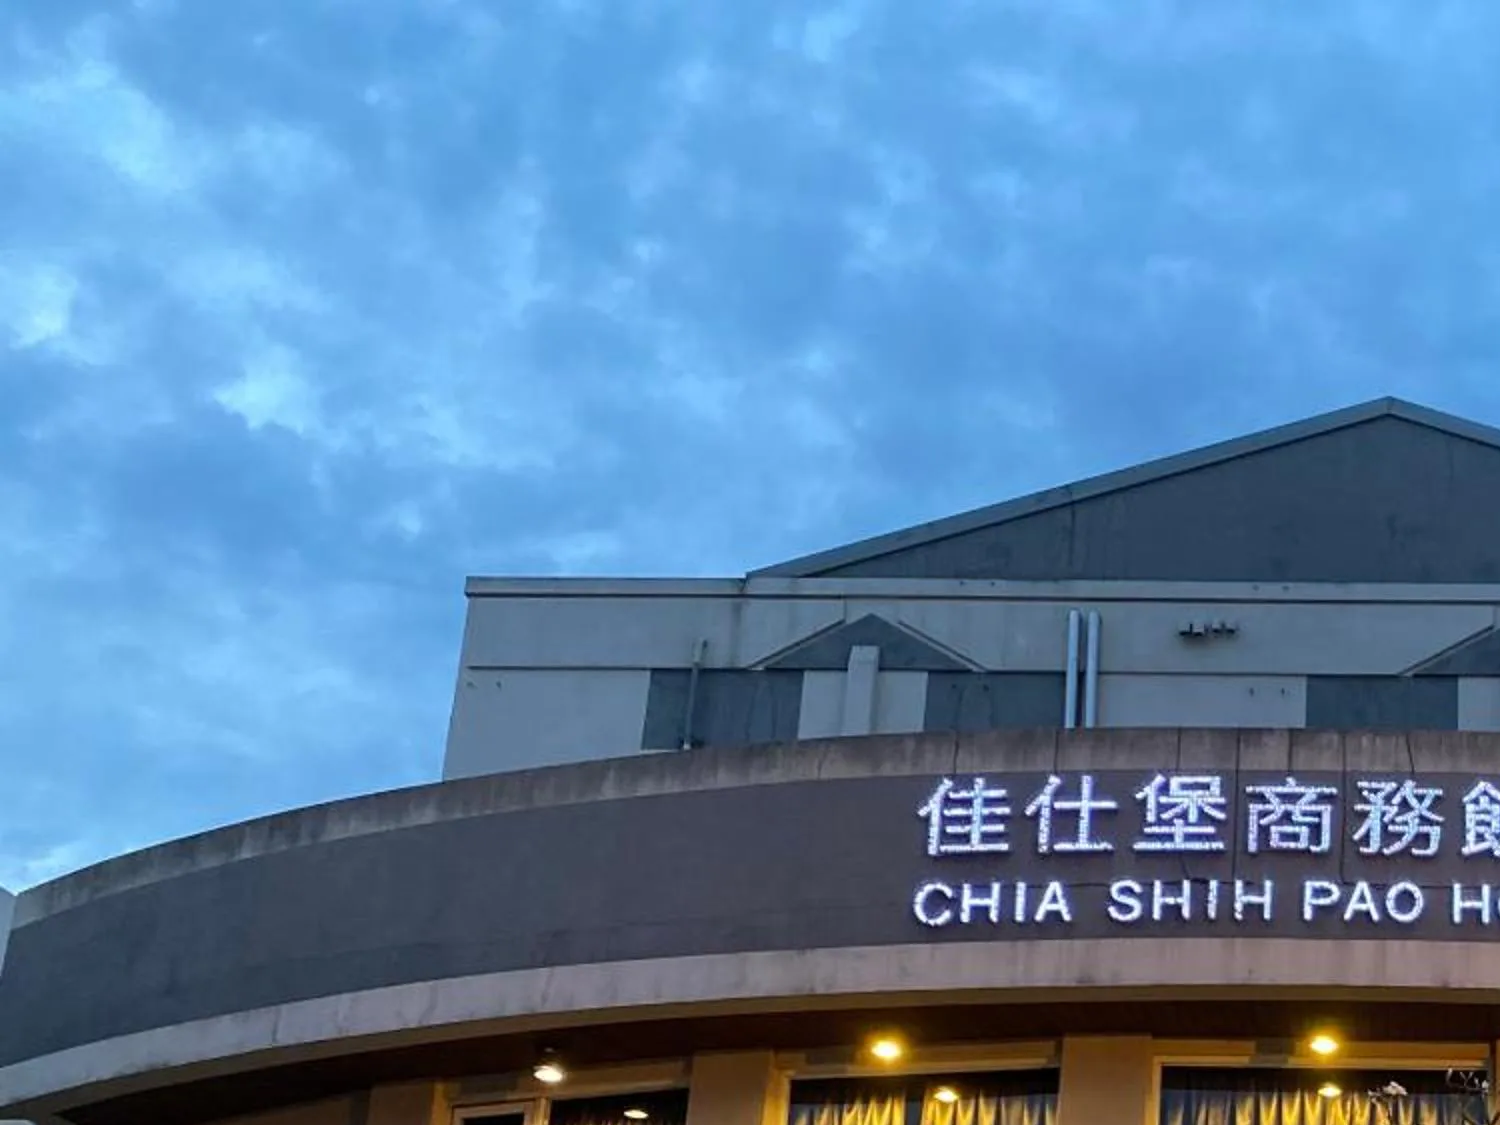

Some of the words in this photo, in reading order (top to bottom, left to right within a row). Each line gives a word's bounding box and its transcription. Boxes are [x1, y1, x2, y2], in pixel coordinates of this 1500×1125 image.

[914, 880, 1072, 926] CHIA
[1107, 879, 1273, 922] SHIH
[1304, 879, 1425, 923] PAO
